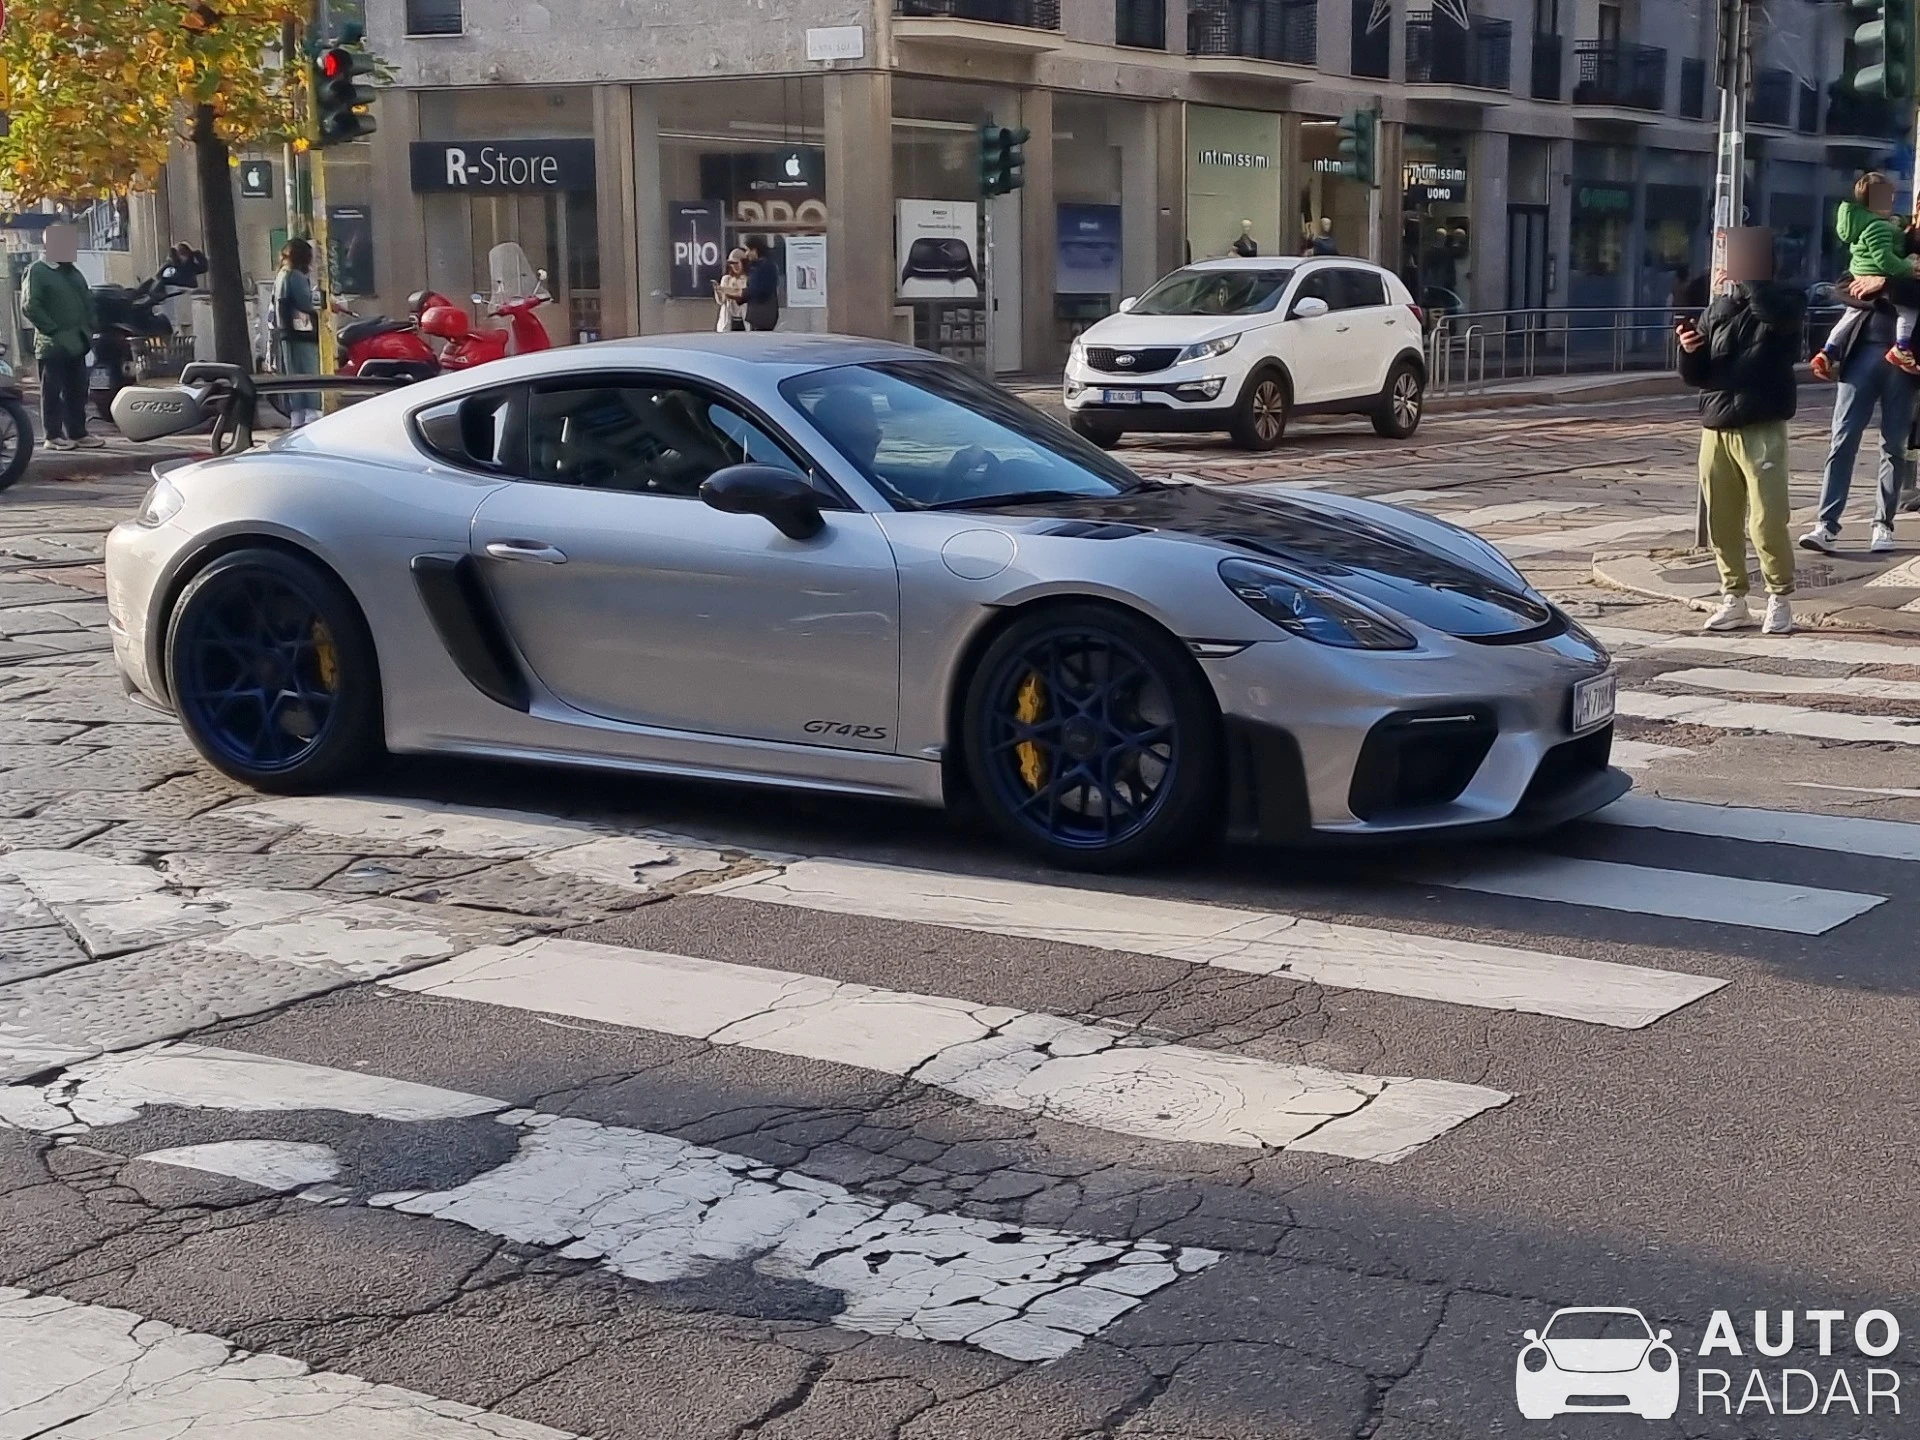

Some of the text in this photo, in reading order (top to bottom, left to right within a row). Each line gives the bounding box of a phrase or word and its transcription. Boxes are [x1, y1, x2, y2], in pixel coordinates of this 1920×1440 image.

[446, 147, 558, 185] R-Store
[1200, 150, 1270, 168] intimissimi
[1313, 159, 1342, 173] intim
[1427, 187, 1451, 200] UOMO
